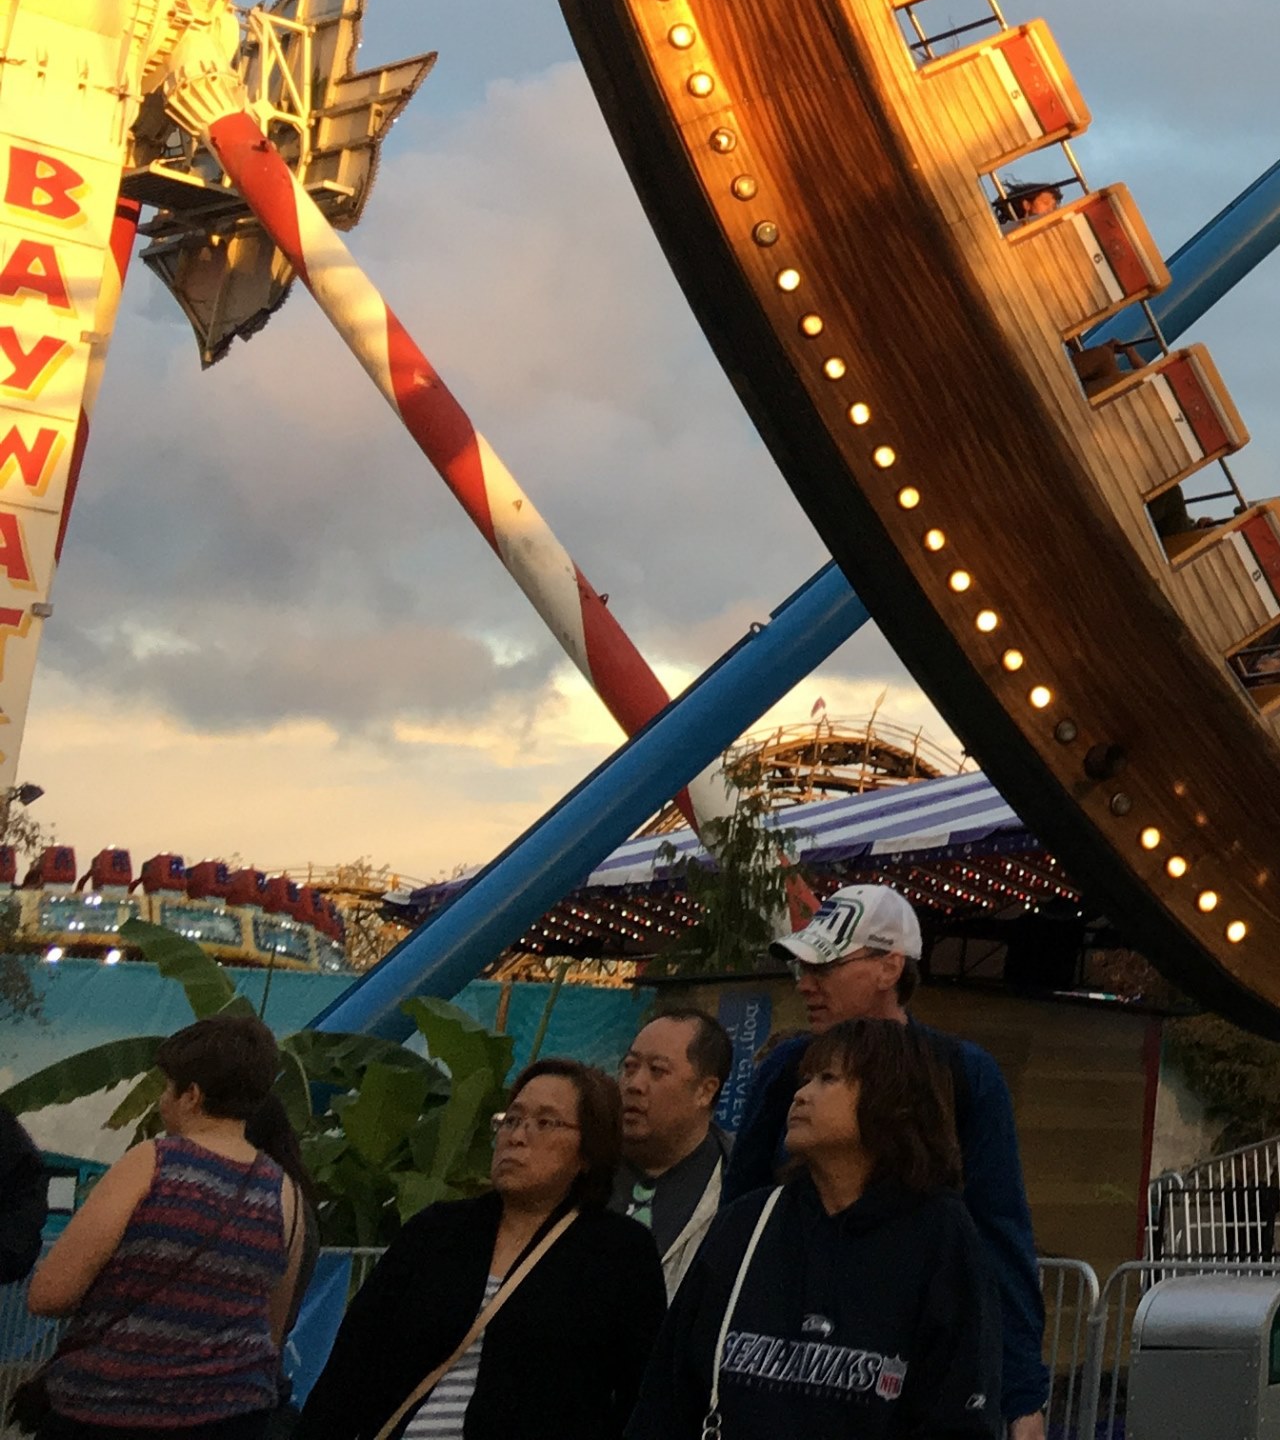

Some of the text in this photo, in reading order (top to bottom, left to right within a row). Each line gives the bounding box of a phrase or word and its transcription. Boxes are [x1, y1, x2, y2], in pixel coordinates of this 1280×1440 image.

[1010, 89, 1021, 100] 5
[1093, 253, 1104, 265] 6
[1252, 569, 1262, 582] 8
[721, 1331, 883, 1391] SEAHAWKS
